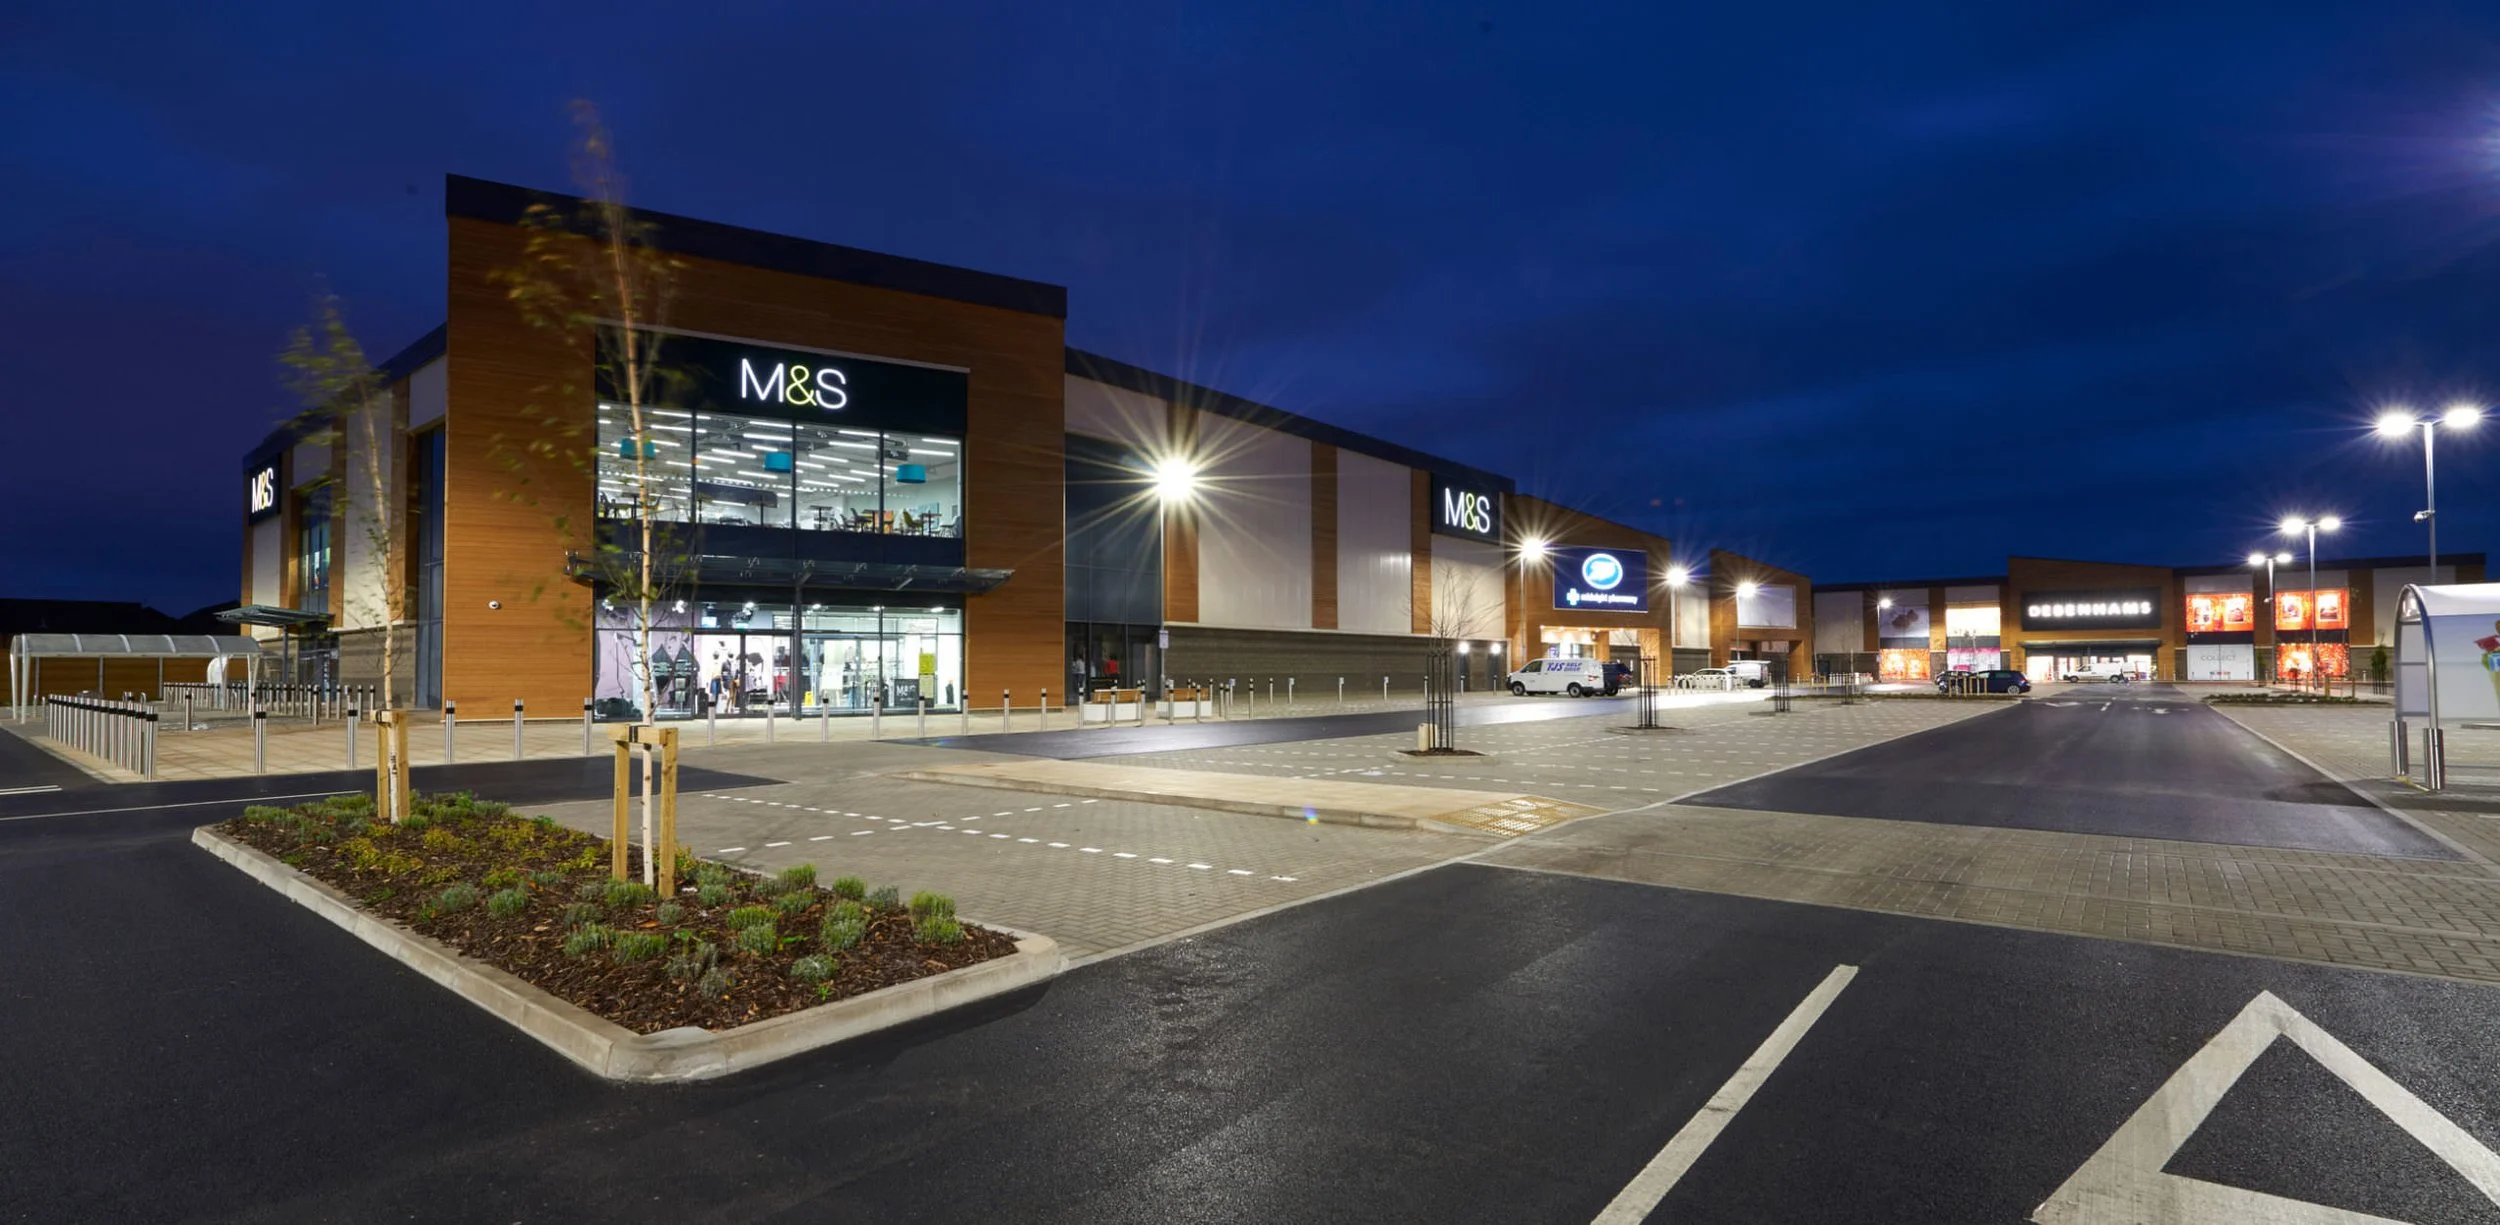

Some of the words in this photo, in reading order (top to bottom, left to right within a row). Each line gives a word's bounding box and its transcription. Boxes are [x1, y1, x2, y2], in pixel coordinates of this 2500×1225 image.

[741, 358, 847, 410] M&S
[251, 467, 274, 513] M&S
[1445, 487, 1491, 534] M&S
[2028, 601, 2152, 618] DEBENHAMS
[1547, 662, 1565, 672] TJS
